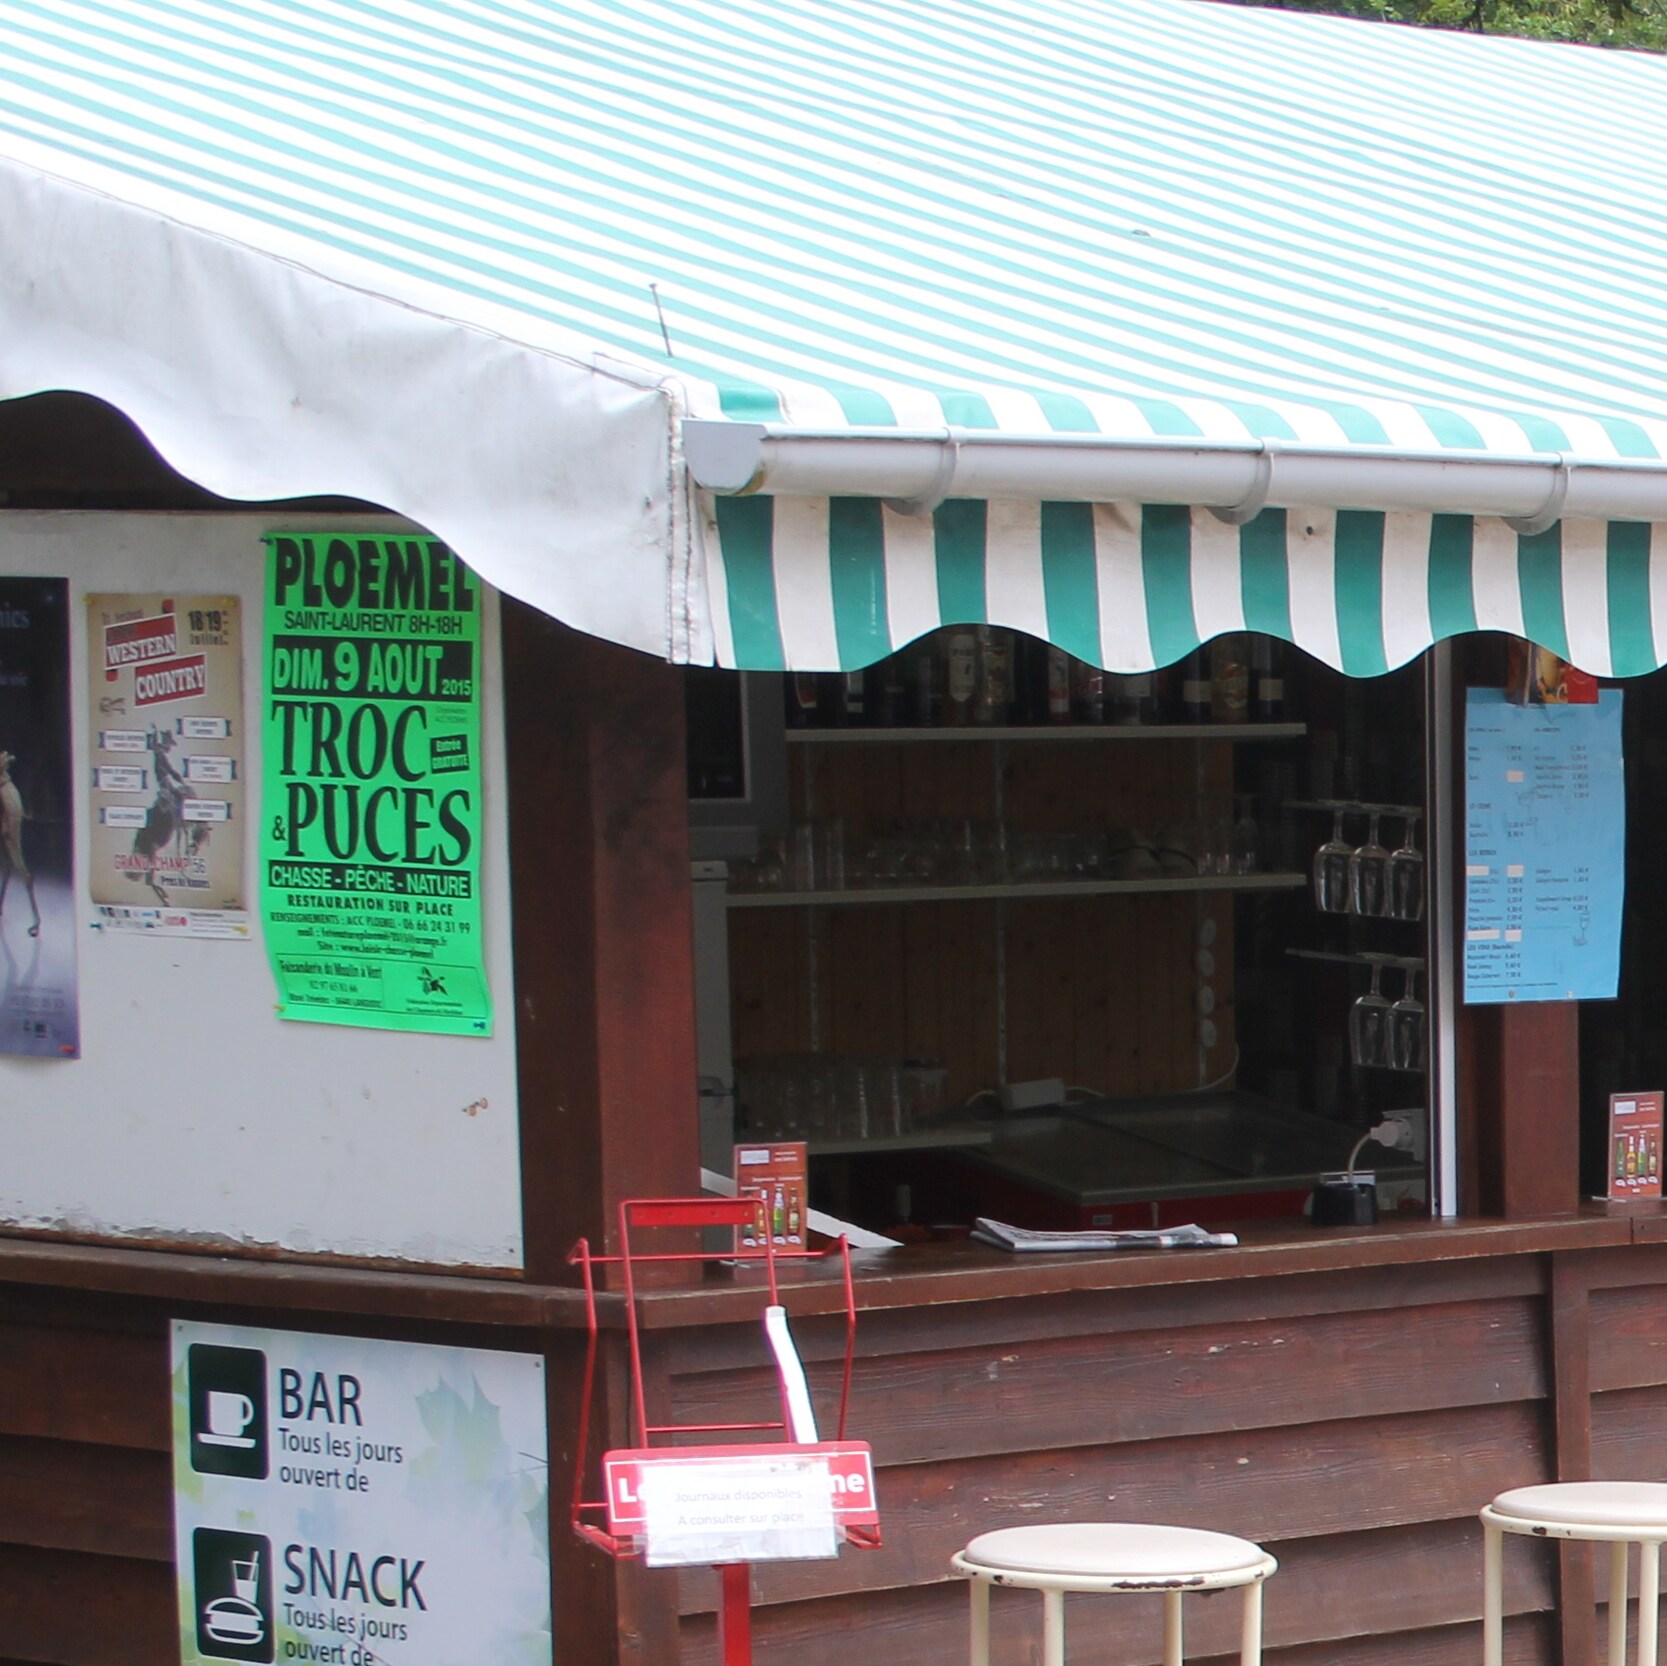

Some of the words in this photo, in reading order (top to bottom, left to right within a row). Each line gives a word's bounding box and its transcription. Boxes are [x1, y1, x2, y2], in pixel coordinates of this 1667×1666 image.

[274, 537, 474, 612] PLOEMEL
[284, 610, 405, 634] SAINT-LAURENT
[408, 615, 463, 634] 8H-18H
[107, 634, 176, 664] WESTERN
[136, 665, 205, 700] COUNTRY
[273, 648, 329, 690] DIM.
[333, 641, 360, 692] 9
[367, 642, 444, 695] AOUT
[441, 679, 472, 696] 2015
[271, 700, 427, 783] TROC
[272, 815, 286, 841] &
[285, 781, 471, 867] PUCES
[271, 866, 333, 888] CHASSE
[345, 864, 395, 892] PÊCHE
[406, 873, 469, 897] NATURE
[271, 912, 340, 924] RENSEIGNEMENTS
[287, 894, 384, 912] RESTAURATION
[389, 900, 410, 914] SUR
[416, 903, 453, 917] PLACE
[279, 1367, 364, 1427] BAR
[278, 1427, 321, 1456] Tous
[326, 1432, 352, 1458] les
[354, 1436, 403, 1464] jours
[280, 1463, 341, 1491] ouvert
[346, 1468, 369, 1493] de
[676, 1491, 731, 1503] Journaux
[734, 1488, 802, 1501] disponibles
[678, 1515, 687, 1525] A
[690, 1513, 747, 1526] consulter
[750, 1515, 768, 1523] sur
[771, 1512, 804, 1525] place
[284, 1544, 428, 1612] SNACK
[283, 1602, 326, 1631] Tous
[331, 1606, 357, 1634] les
[359, 1610, 408, 1641] jours
[284, 1638, 345, 1666] ouvert
